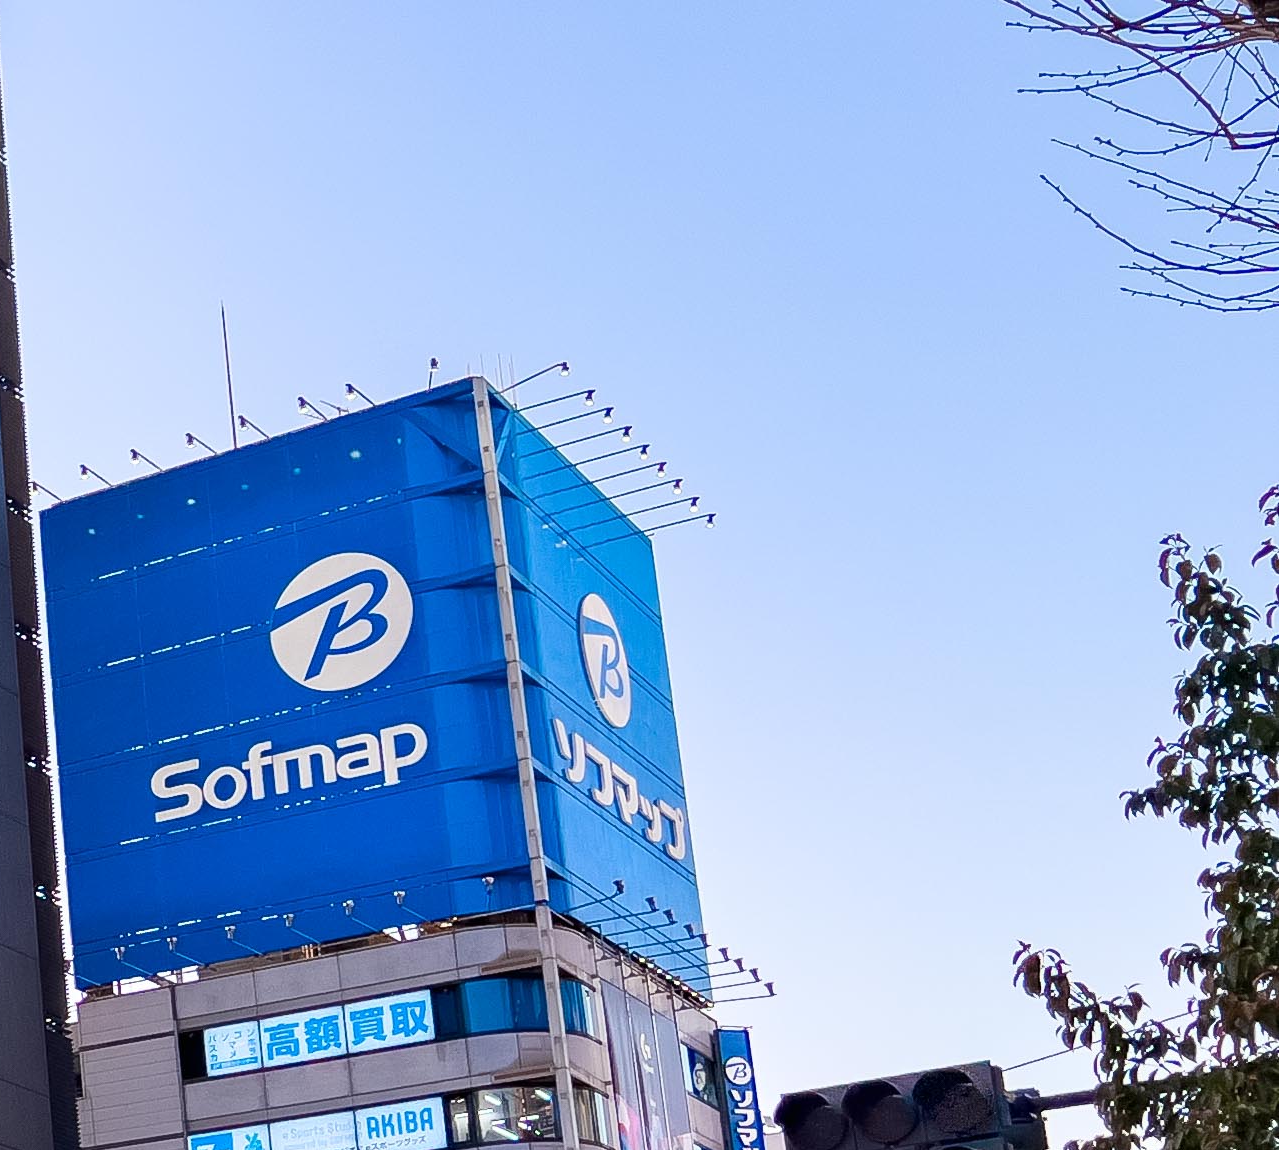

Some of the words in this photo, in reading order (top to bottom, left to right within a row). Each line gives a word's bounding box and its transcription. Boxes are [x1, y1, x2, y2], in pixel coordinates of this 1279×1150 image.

[150, 722, 428, 823] Sofmap
[552, 717, 689, 862] ソフマップ
[263, 999, 430, 1060] 高額買取
[366, 1107, 434, 1139] AKIBA
